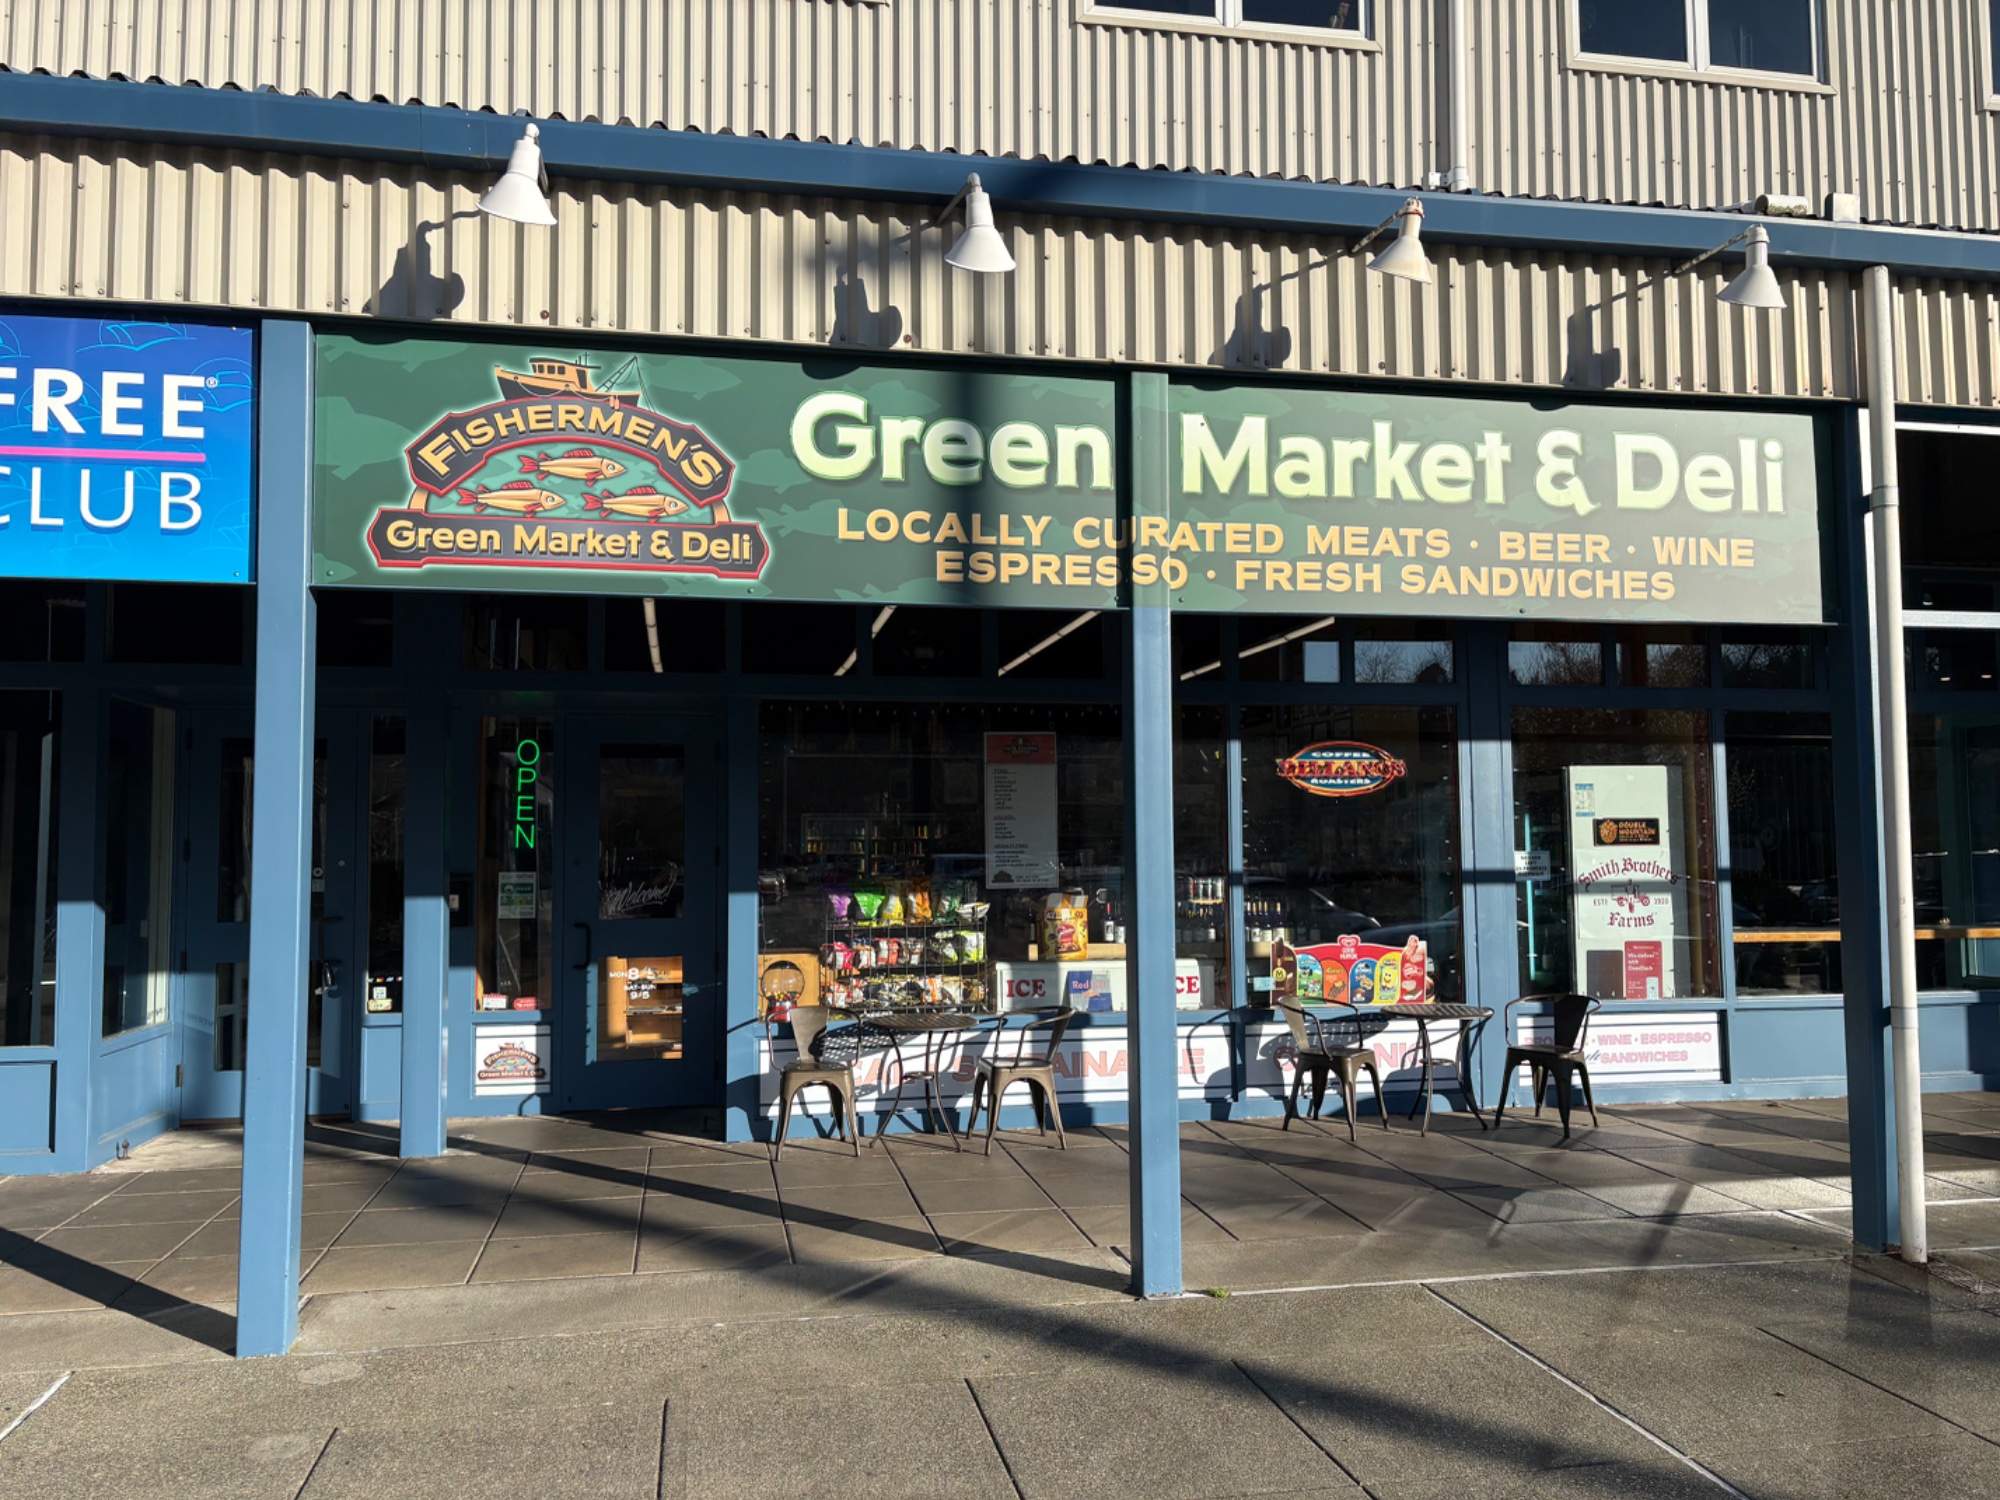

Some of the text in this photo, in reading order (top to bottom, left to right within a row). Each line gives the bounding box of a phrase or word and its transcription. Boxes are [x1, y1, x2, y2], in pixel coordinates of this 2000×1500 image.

[418, 403, 722, 487] FISHERMEN'S
[790, 391, 1785, 516] Green Market & Deli
[386, 519, 752, 563] Green Market & Deli
[837, 507, 1756, 568] LOCALLY CURATED MEATS BEER WINE
[936, 550, 1676, 601] ESPRESSO FRESH SANDWICHES
[514, 739, 540, 849] OPEN
[1578, 857, 1680, 892] Smith Brothers
[1608, 911, 1655, 929] Farms
[1007, 979, 1046, 998] ICE
[1072, 979, 1089, 989] Red
[1175, 976, 1200, 994] CE
[1597, 1034, 1632, 1046] WINE
[1640, 1031, 1712, 1046] ESPRESSO
[1600, 1050, 1689, 1065] SANDWICHES
